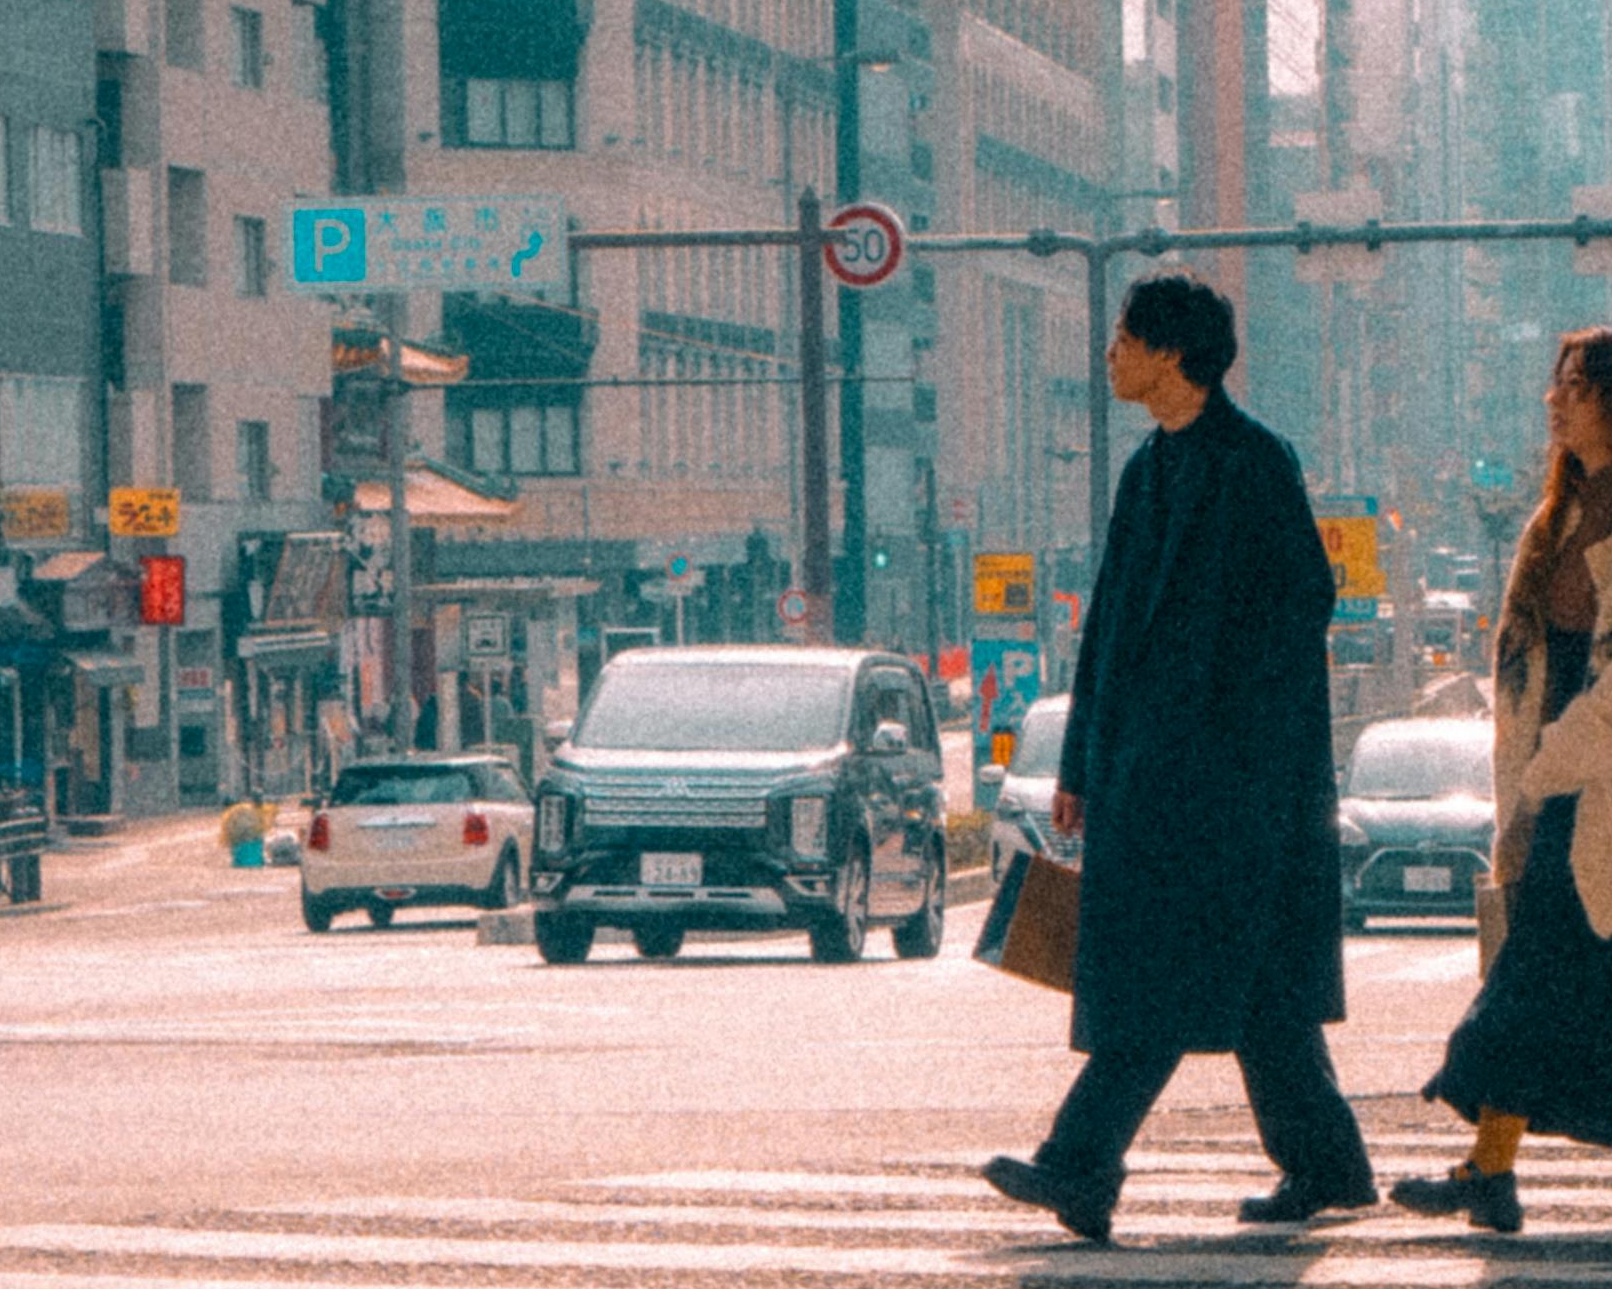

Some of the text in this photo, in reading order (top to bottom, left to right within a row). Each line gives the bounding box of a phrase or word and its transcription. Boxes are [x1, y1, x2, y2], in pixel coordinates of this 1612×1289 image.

[314, 218, 352, 273] P
[842, 227, 886, 264] 50
[1003, 652, 1033, 688] P
